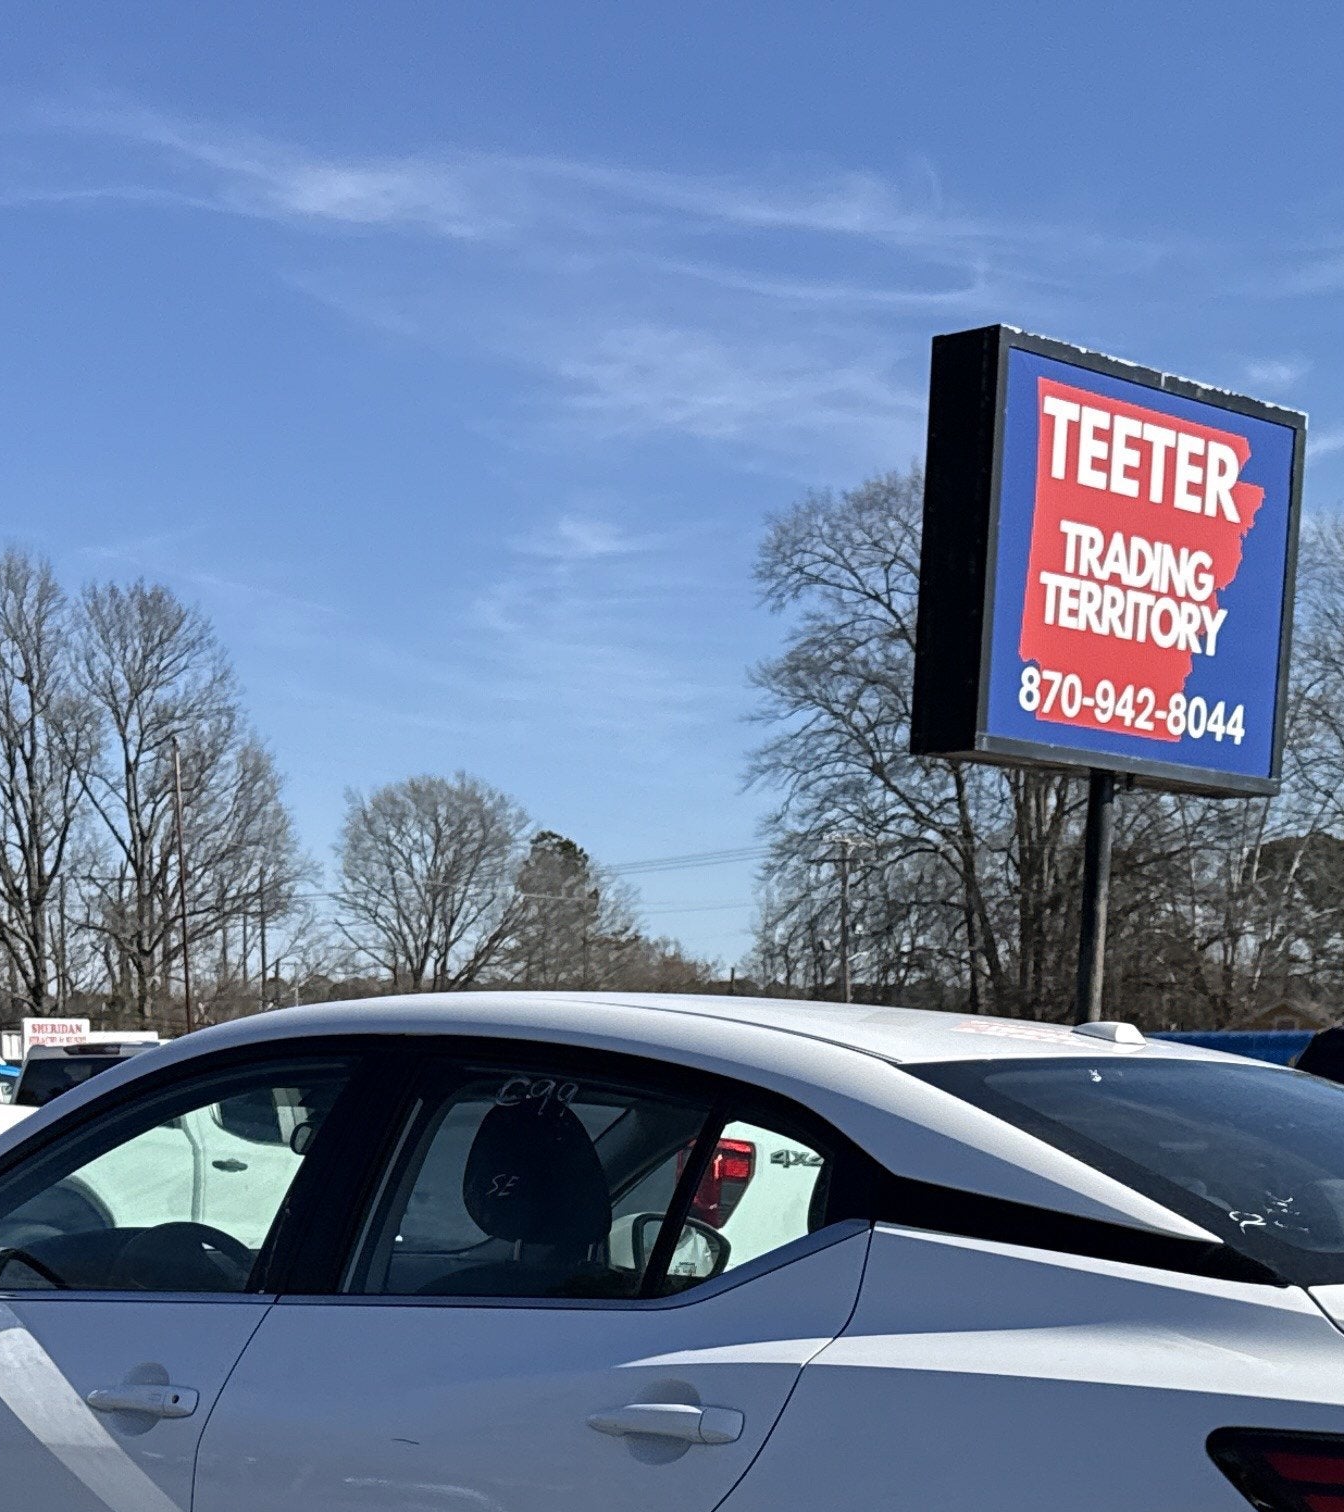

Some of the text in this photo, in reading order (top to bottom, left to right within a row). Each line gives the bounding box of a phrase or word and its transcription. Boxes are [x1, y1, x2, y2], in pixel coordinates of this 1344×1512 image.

[1043, 395, 1240, 524] TEETER
[1059, 519, 1214, 602] TRADING
[1039, 571, 1228, 657] TERRITORY
[1019, 666, 1245, 746] 870-942-8044
[31, 1023, 83, 1034] SHERIDAN
